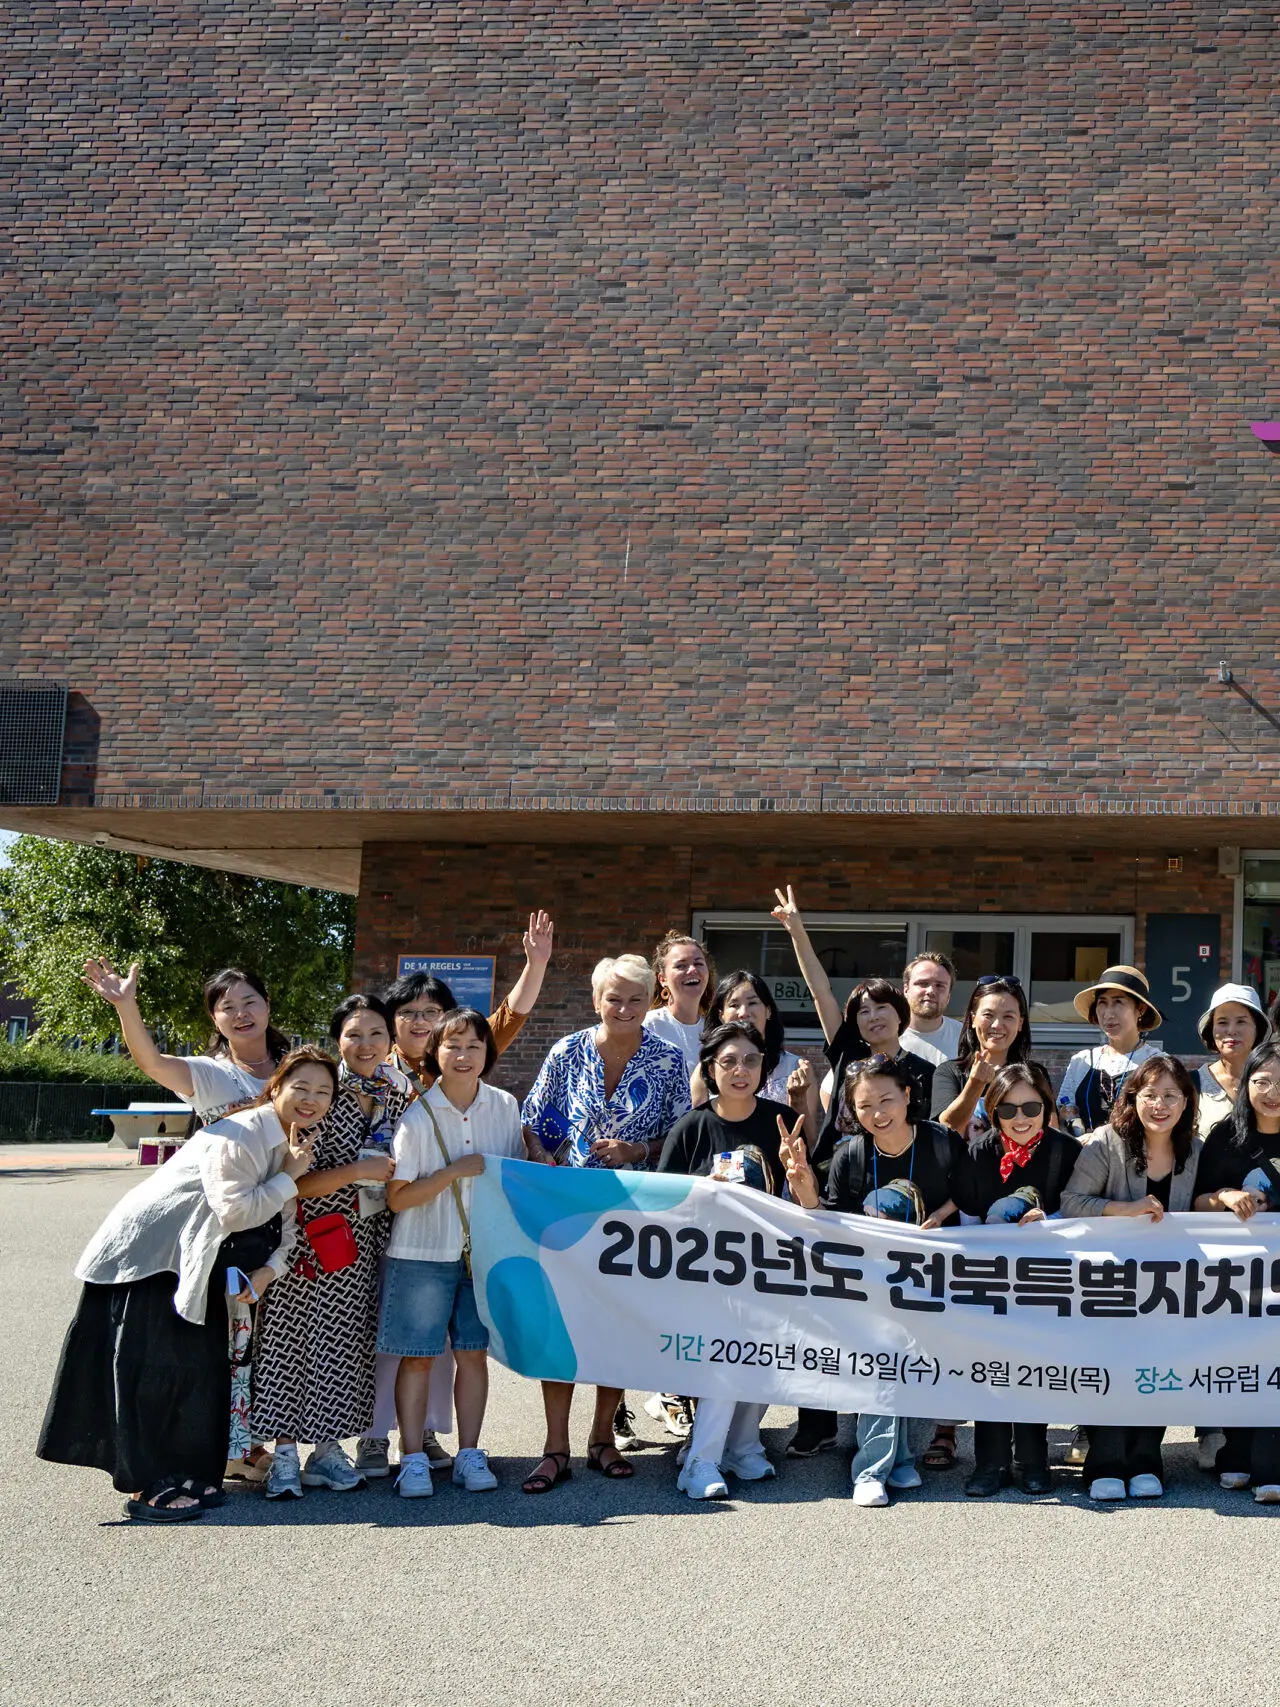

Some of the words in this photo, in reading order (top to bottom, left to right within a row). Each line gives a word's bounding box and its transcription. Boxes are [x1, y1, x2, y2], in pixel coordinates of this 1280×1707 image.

[404, 962, 415, 970] DE
[418, 962, 427, 970] 14
[430, 962, 461, 971] REGELS
[1171, 966, 1192, 1003] 5
[598, 1220, 868, 1301] 2025년도
[660, 1333, 705, 1362] 기간
[709, 1339, 797, 1371] 2025년
[802, 1346, 841, 1376] 8월
[848, 1351, 941, 1386] 13일(수)
[971, 1360, 1010, 1388] 8월
[1017, 1363, 1110, 1395] 21일(목)
[1134, 1366, 1184, 1395] 장소
[1188, 1364, 1259, 1394] 서유럽
